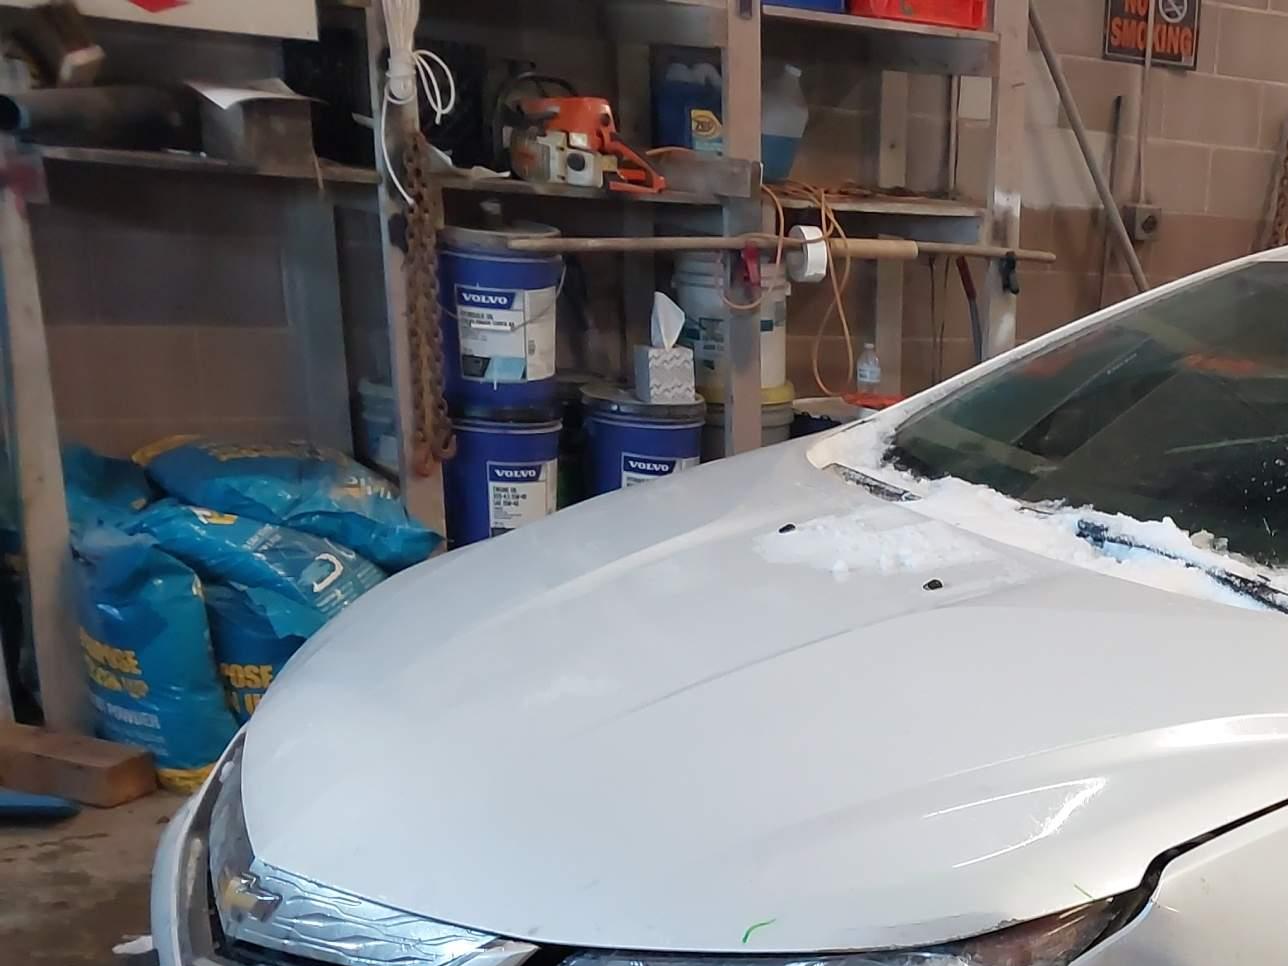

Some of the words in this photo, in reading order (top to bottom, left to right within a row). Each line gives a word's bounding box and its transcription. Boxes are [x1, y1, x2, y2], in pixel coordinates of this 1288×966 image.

[462, 292, 508, 305] VOLVO
[627, 459, 669, 472] VOLVO
[494, 468, 537, 478] VOLVO
